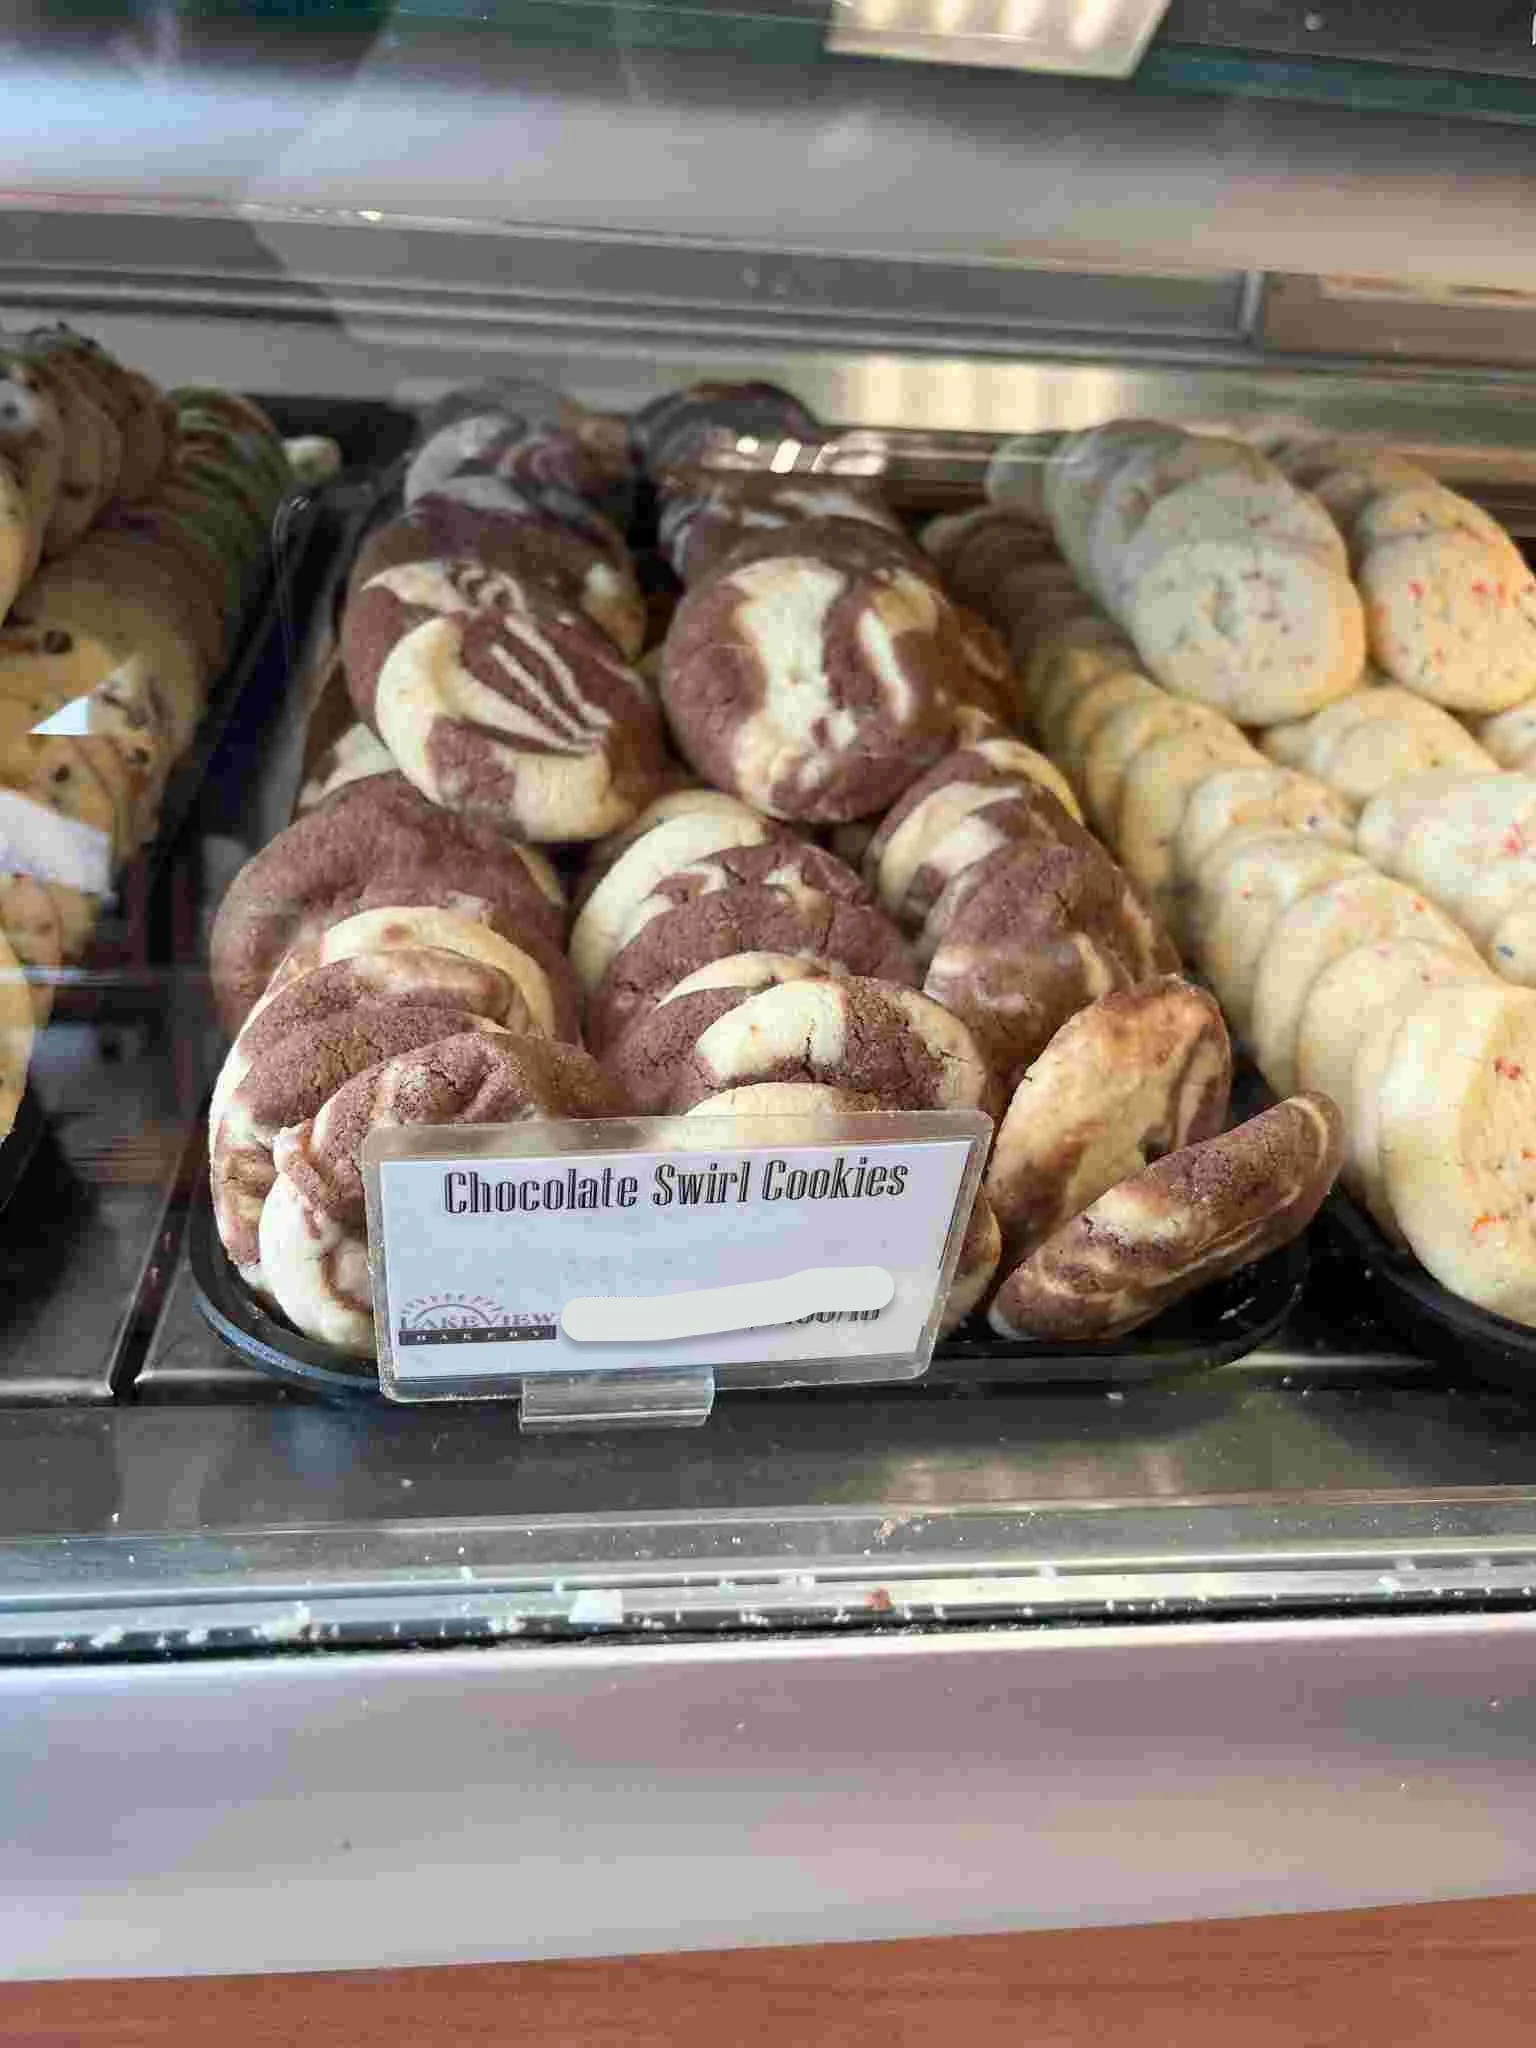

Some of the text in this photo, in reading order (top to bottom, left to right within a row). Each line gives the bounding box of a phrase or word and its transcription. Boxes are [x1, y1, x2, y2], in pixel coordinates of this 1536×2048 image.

[444, 1156, 909, 1214] Chocolate Swirl Cookies
[400, 1312, 556, 1330] LAKEVIEW
